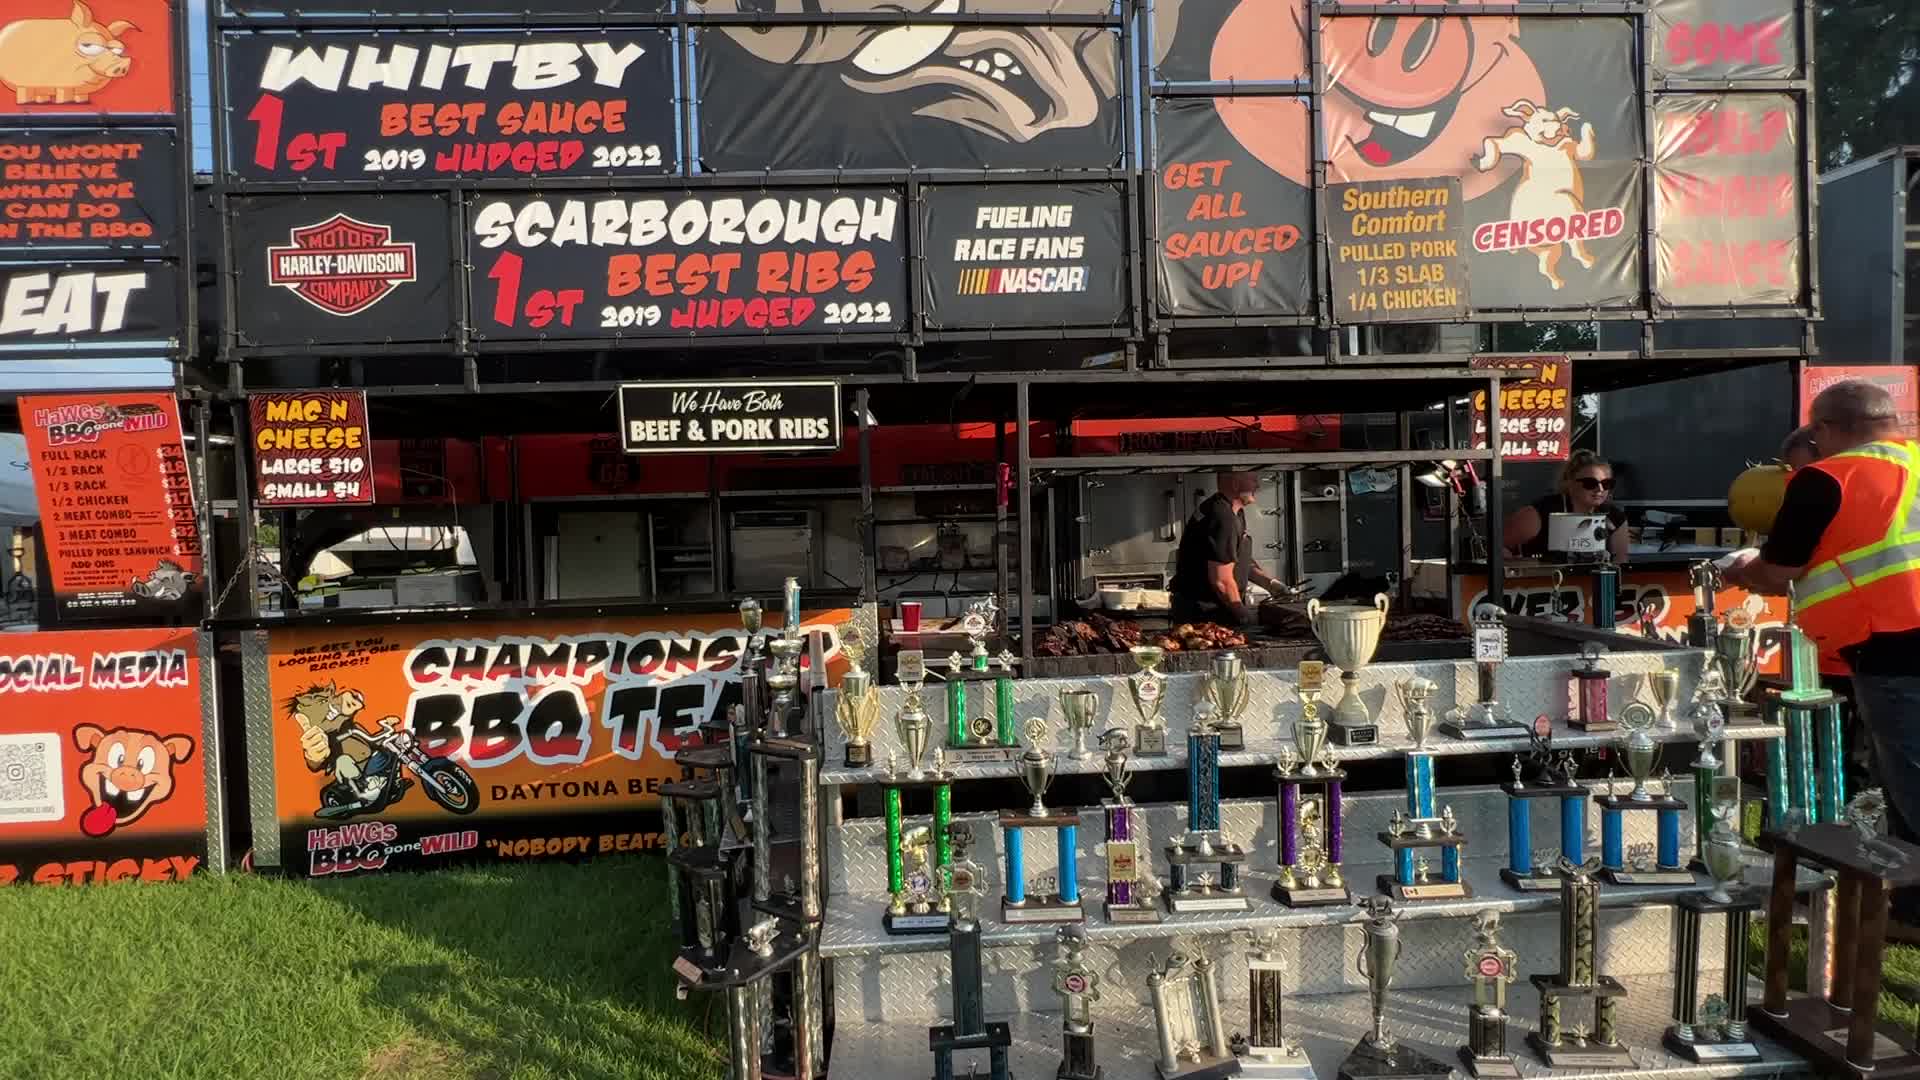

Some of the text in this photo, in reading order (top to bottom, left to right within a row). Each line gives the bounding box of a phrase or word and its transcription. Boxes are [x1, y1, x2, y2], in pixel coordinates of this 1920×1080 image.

[1666, 20, 1784, 65] SOME
[260, 43, 646, 93] WHITBY
[380, 100, 627, 137] BEST SAUCE
[247, 93, 346, 171] 1ST
[50, 144, 144, 160] WONT
[364, 141, 663, 172] 2019 JUDGED 2022
[5, 162, 118, 180] BELIEVE
[1164, 160, 1233, 189] GET
[0, 182, 135, 199] WHAT WE
[1343, 185, 1448, 211] Southern
[5, 203, 120, 218] CAN DO
[975, 204, 1073, 229] FUELING
[1187, 192, 1247, 220] ALL
[26, 222, 83, 238] THE
[473, 197, 897, 249] SCARBOROUGH
[1351, 210, 1447, 237] Comfort
[1474, 208, 1624, 251] CENSORED
[309, 226, 375, 248] MOTOR
[954, 236, 1085, 262] RACE FANS
[1165, 225, 1301, 261] SAUCED
[1340, 240, 1457, 263] PULLED PORK
[280, 253, 405, 276] HARLEY-DAVIDSON
[608, 250, 875, 296] BEST RIBS
[1202, 259, 1264, 290] UP!
[1357, 264, 1445, 287] 1/3 SLAB
[488, 252, 584, 327] 1ST
[999, 265, 1085, 294] NASCAR
[0, 272, 146, 335] EAT
[310, 280, 377, 306] COMPANY
[1349, 288, 1457, 312] 1/4 CHICKEN
[601, 298, 892, 328] 2019 JUDGED 2022
[1541, 364, 1558, 383] N
[266, 400, 348, 422] MAC N
[672, 390, 783, 414] We Have Both
[1475, 389, 1568, 411] CEESE
[48, 420, 99, 446] BBQ
[123, 413, 168, 431] WILD
[630, 418, 829, 441] BEEF & PORK RIBS
[1475, 418, 1565, 433] LRGE $10
[257, 427, 362, 450] CHEESE
[1537, 441, 1559, 456] $4
[41, 451, 70, 462] FULL
[74, 449, 107, 460] RACK
[262, 457, 364, 474] LARGE $10
[46, 466, 67, 477] 1/2
[72, 464, 104, 475] RACK
[75, 479, 107, 490] RACK
[264, 481, 359, 499] SMALL $4
[52, 497, 73, 507] 1/2
[77, 495, 129, 506] CHICKEN
[54, 512, 60, 521] 2
[64, 511, 92, 521] MEAT
[95, 509, 132, 520] COMBO
[69, 529, 96, 540] MEAT
[100, 528, 136, 539] COMBO
[59, 548, 94, 558] PULLED
[96, 547, 121, 557] PORK
[125, 545, 171, 556] SANDWICH
[71, 560, 91, 568] ADD
[89, 649, 188, 689] MEDIA
[279, 652, 342, 667] LOOKING
[346, 648, 366, 658] AT
[404, 683, 591, 768] BBQ
[491, 777, 690, 801] DAYTONA BEA
[308, 822, 397, 850] HaWGs
[600, 832, 669, 852] BEATS
[310, 831, 478, 876] BBQ gone WILD
[33, 856, 199, 886] STICKY
